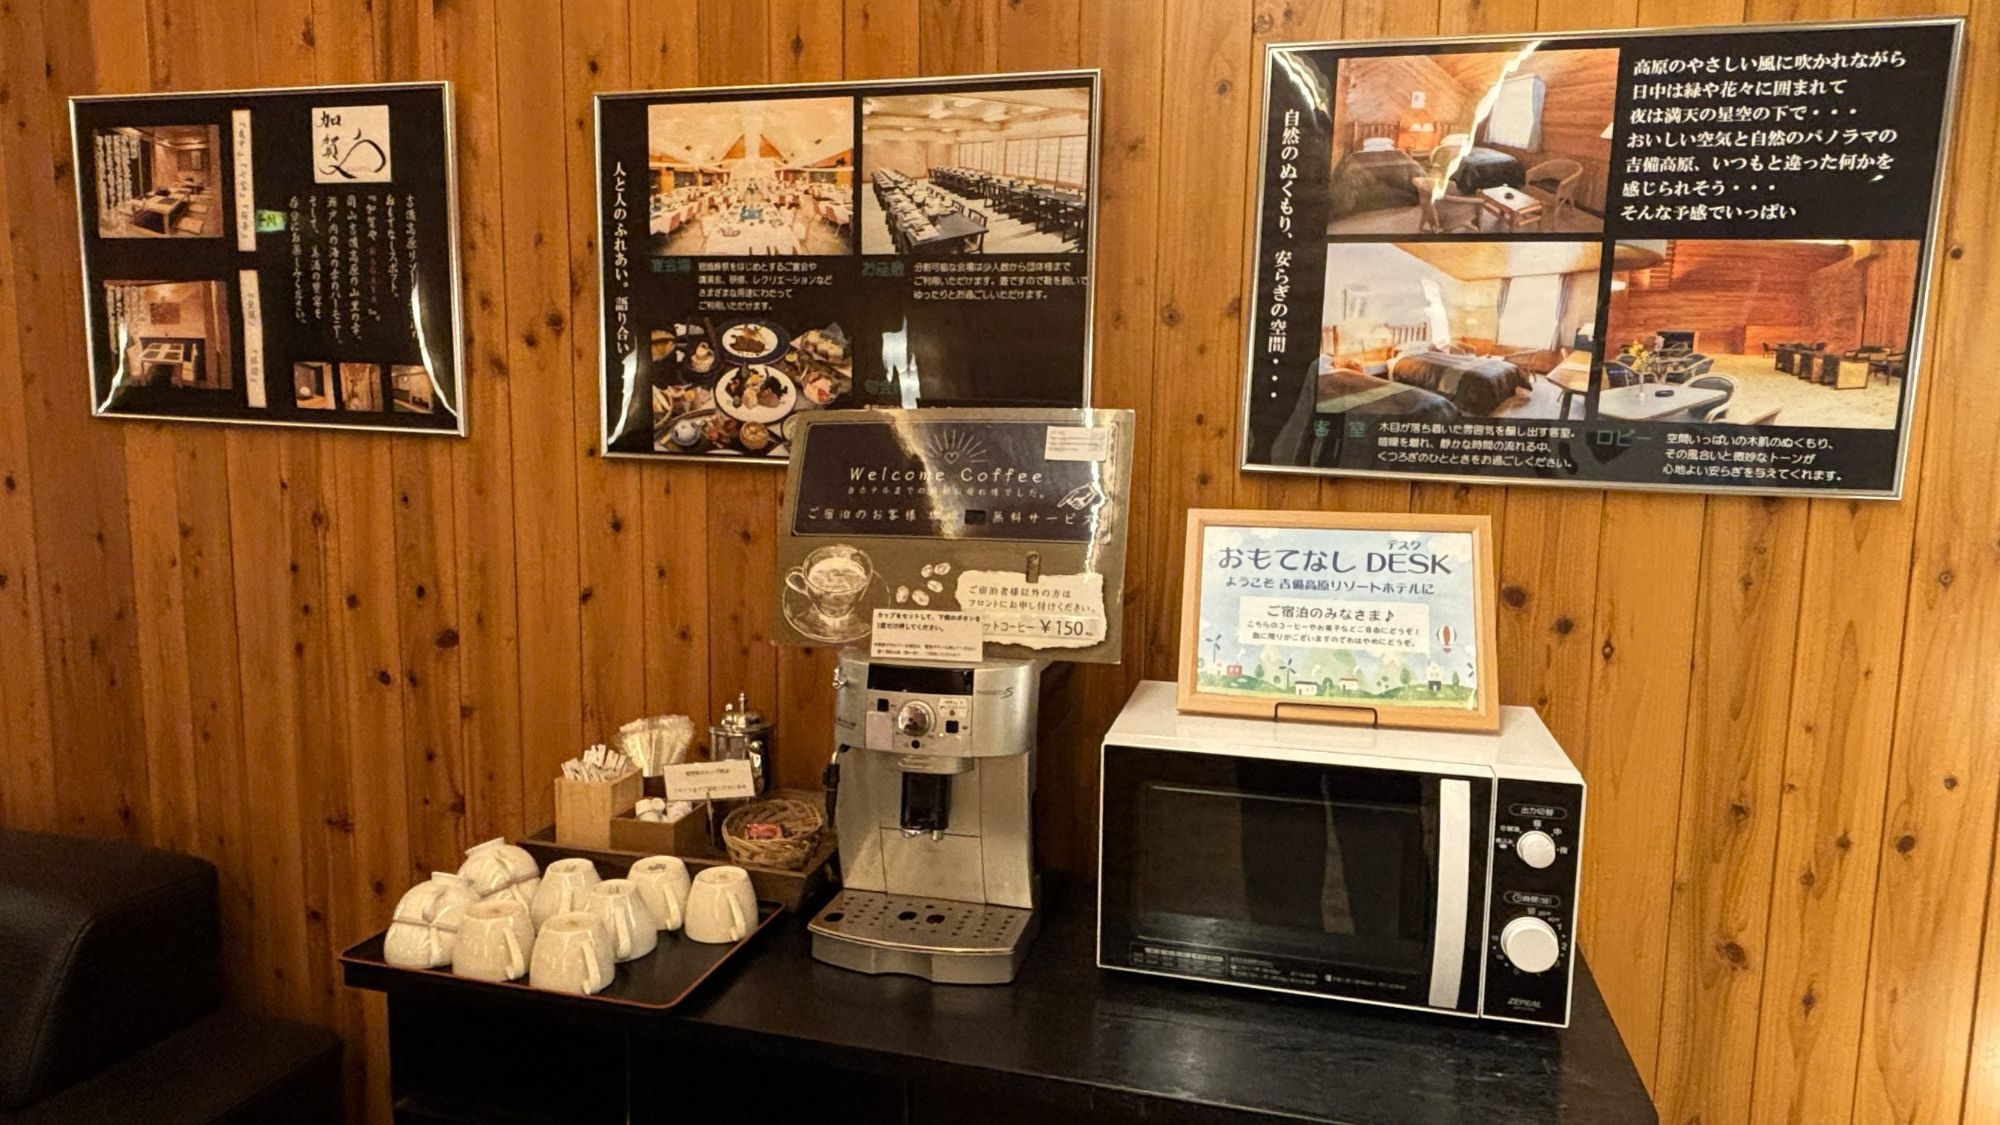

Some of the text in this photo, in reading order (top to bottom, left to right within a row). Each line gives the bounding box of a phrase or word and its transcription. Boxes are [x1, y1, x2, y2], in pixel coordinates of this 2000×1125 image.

[1633, 51, 1907, 76] 高原のやさしい風に吹かれながら
[1632, 79, 1848, 100] 日中は緑や花々に囲まれて
[1630, 105, 1857, 125] 夜は満天の星空の下で・・・
[1627, 128, 1898, 149] おいしい空気と自然のパノラマの
[1625, 153, 1894, 173] 吉備高原、いつもと違った何かを
[1622, 179, 1776, 198] 感じられそう・・・
[1620, 204, 1797, 222] そんな予感でいっぱい
[1596, 428, 1653, 446] ロビー
[850, 467, 1043, 484] Welcome Coffee
[1662, 464, 1842, 481] 心地よい安らぎを与えてくれます。
[1387, 540, 1421, 551] デスク
[1218, 546, 1452, 575] おもてなし DESK
[1224, 577, 1435, 595] ようこそ 吉備高原リゾートホテルに
